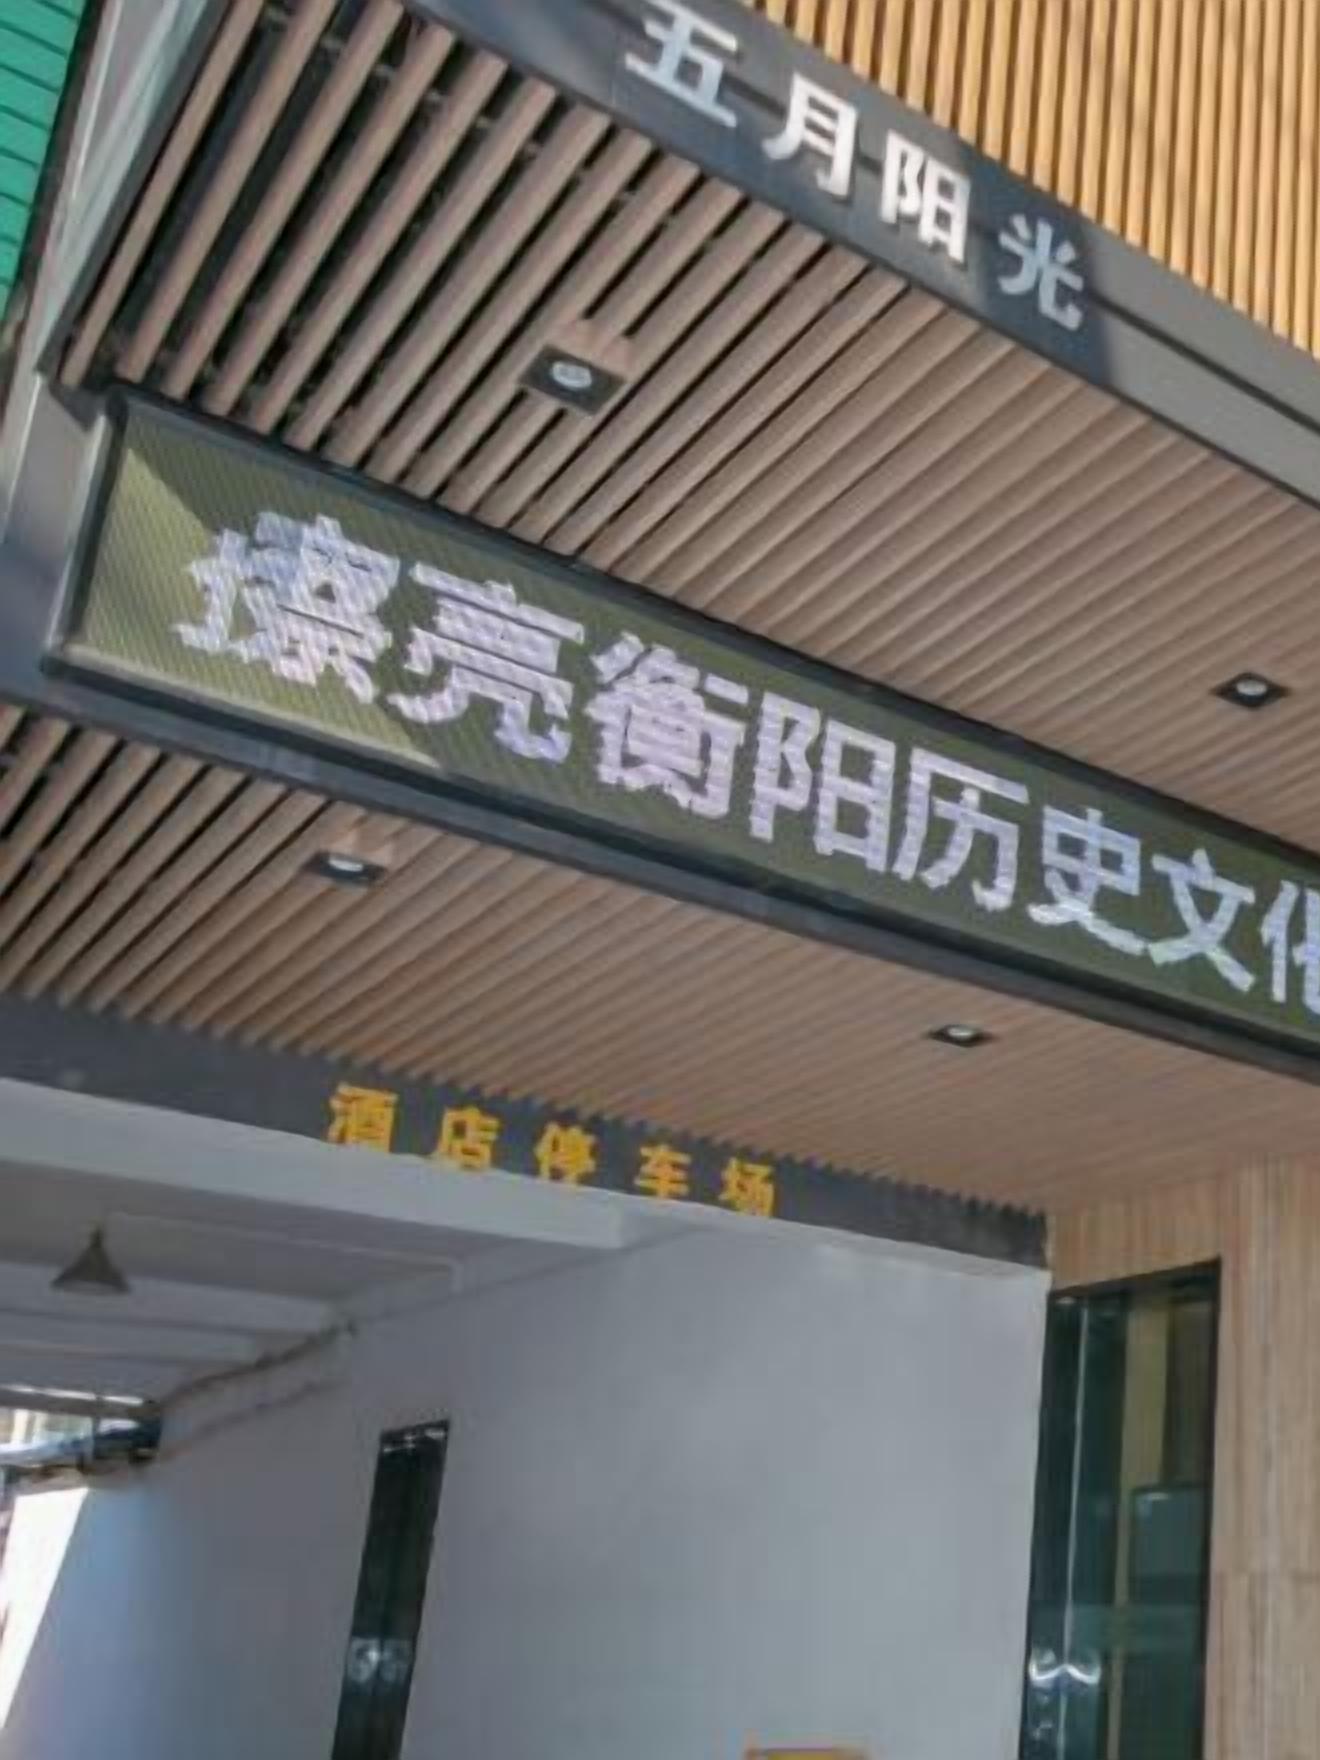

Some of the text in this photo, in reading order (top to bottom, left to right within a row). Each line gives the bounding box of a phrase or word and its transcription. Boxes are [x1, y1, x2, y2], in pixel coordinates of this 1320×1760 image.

[624, 0, 1085, 331] 五月阳光
[328, 1081, 776, 1219] 酒店停车场
